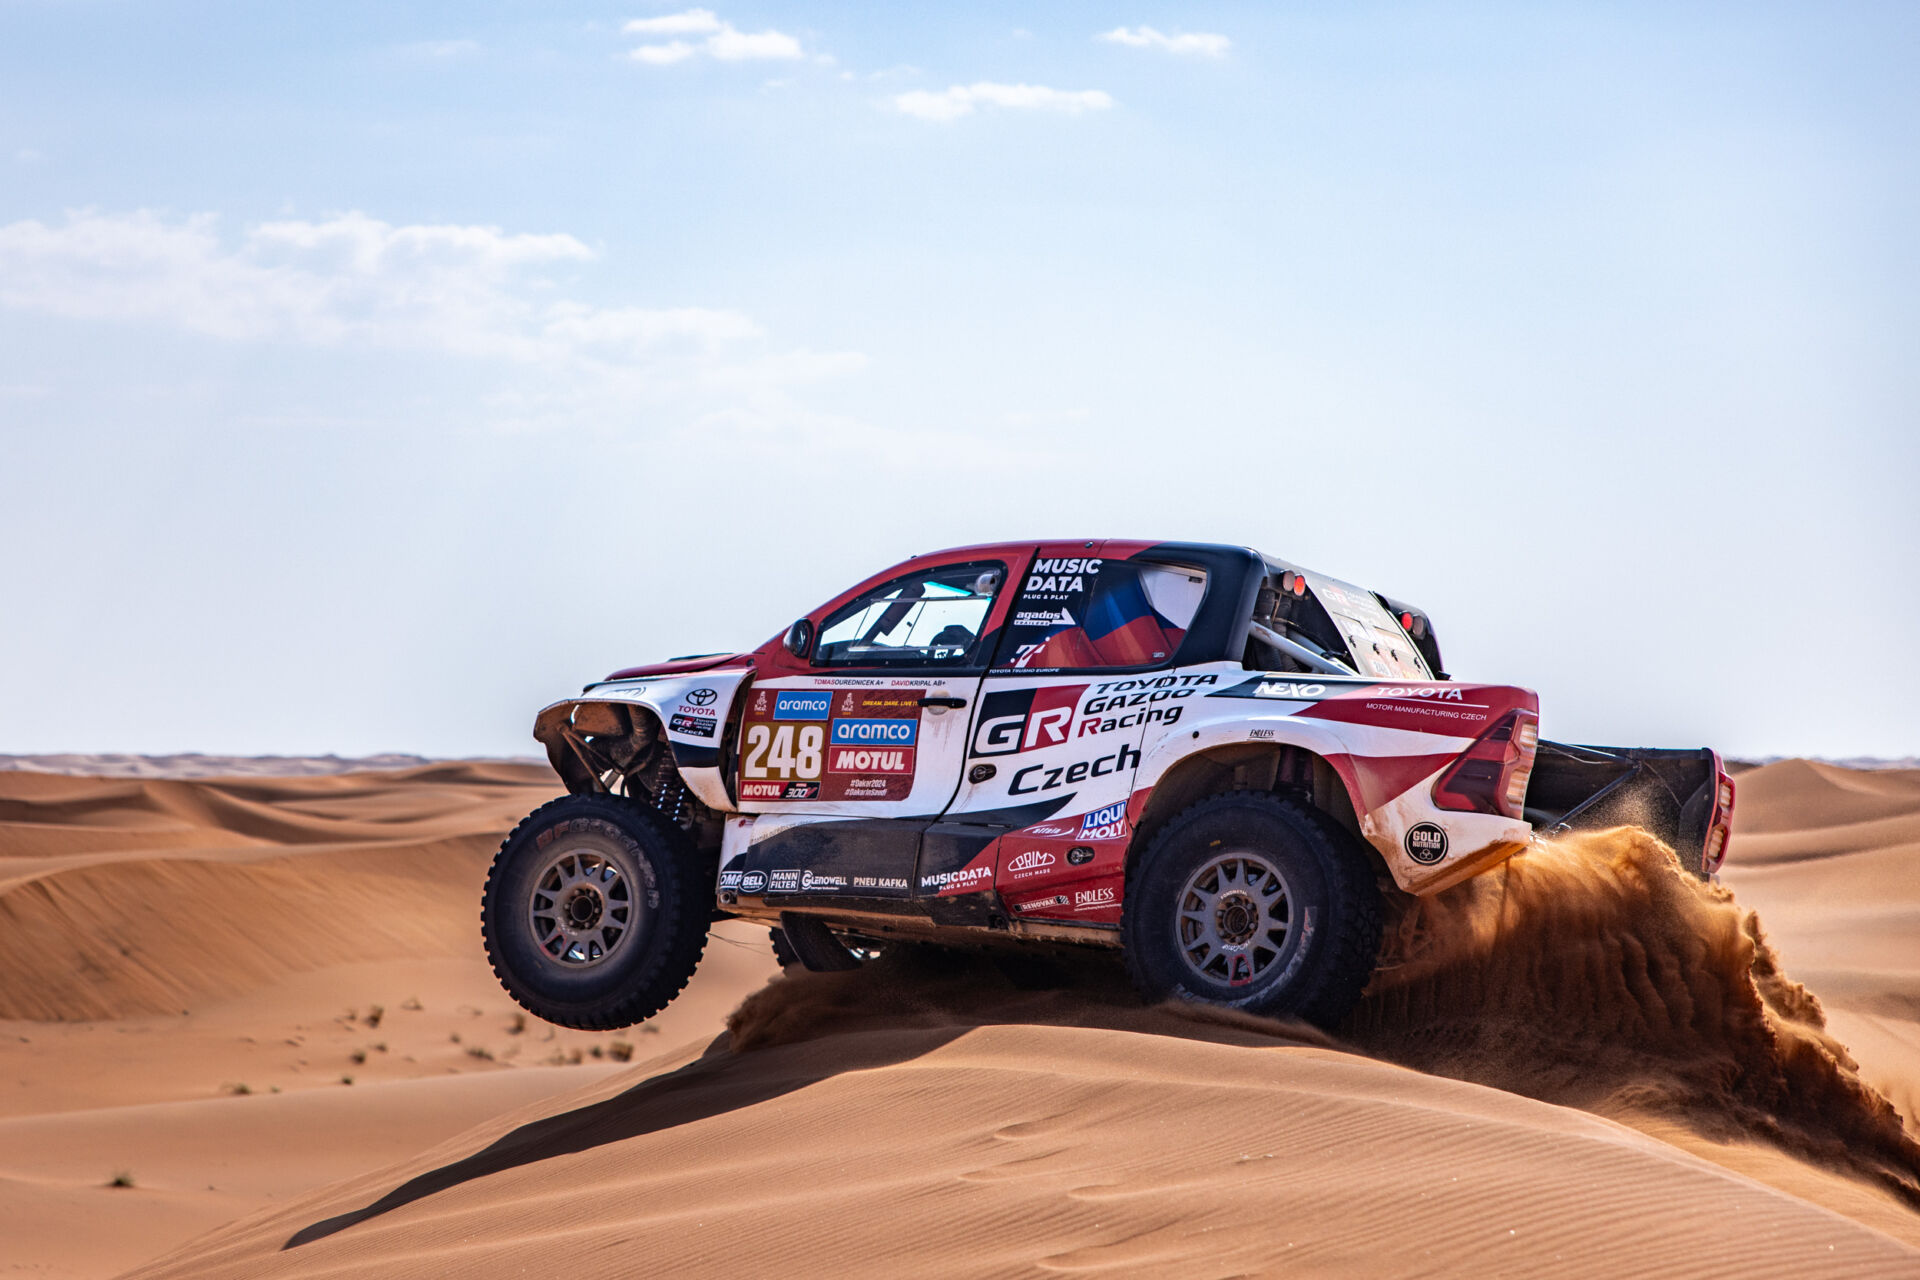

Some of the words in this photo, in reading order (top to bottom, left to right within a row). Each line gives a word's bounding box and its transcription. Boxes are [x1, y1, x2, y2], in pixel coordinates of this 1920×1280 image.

[1032, 559, 1102, 574] MUSIC
[1026, 576, 1084, 592] DATA
[1016, 610, 1060, 620] agados
[1097, 674, 1219, 694] TOYOTA
[1253, 682, 1326, 697] NEXO
[1378, 687, 1463, 700] TOYOTA
[778, 699, 827, 711] aramco
[1083, 688, 1197, 715] GAZOO
[678, 705, 716, 716] TOYOTA
[1366, 703, 1393, 711] MOTOR
[1394, 706, 1459, 718] MANUFACTURING
[1460, 712, 1487, 720] CZECH
[672, 717, 693, 727] GR
[1077, 706, 1184, 737] Racing
[837, 720, 911, 740] aramco
[975, 706, 1073, 754] GR
[745, 725, 824, 779] 248
[835, 751, 905, 770] MOTUL
[1007, 744, 1141, 795] Czech
[850, 779, 886, 787] #Dakar2024
[742, 785, 781, 797] MOTUL
[785, 786, 818, 798] 300V
[1085, 803, 1125, 828] LIQUI
[1080, 819, 1124, 840] MOLY
[1412, 830, 1441, 842] GOLD
[1412, 841, 1441, 849] NUTRITION
[1015, 851, 1048, 869] PRIM
[743, 875, 763, 886] BELL
[772, 872, 798, 881] MANN
[854, 876, 876, 886] PNEU
[879, 878, 908, 888] KAFKA
[922, 866, 992, 887] MUSICDATA
[1014, 871, 1033, 879] CZECH
[770, 880, 797, 889] FILTER
[1075, 887, 1114, 904] ENDLESS
